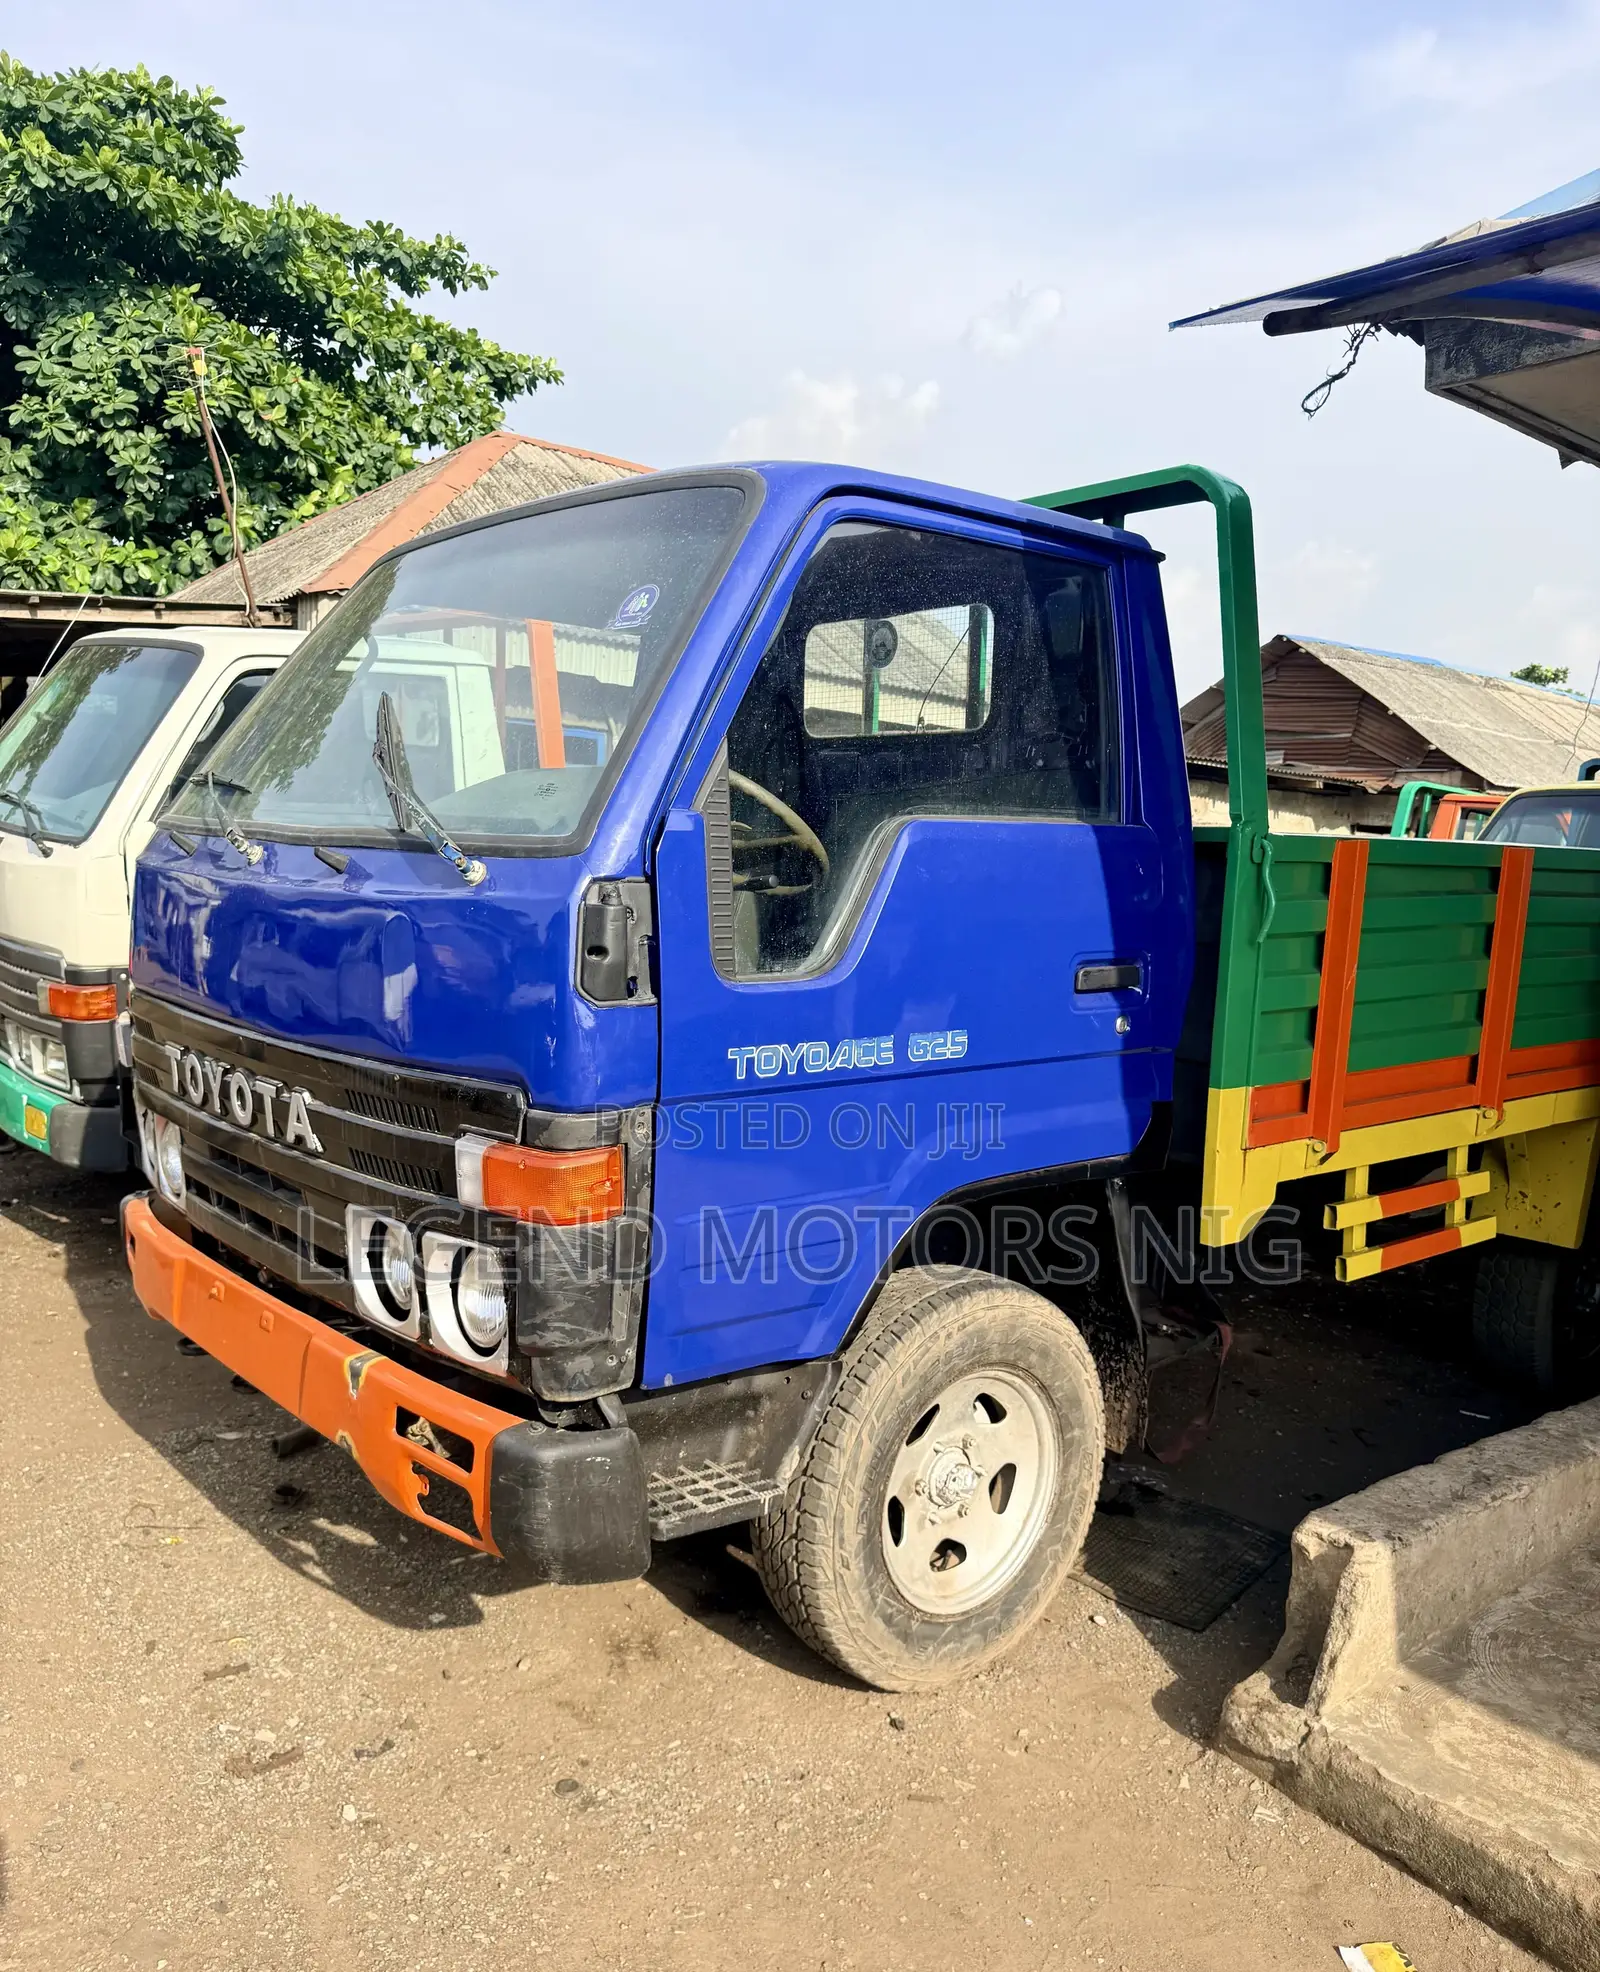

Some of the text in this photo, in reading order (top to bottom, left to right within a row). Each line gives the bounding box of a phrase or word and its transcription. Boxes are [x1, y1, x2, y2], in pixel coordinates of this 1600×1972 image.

[728, 1030, 968, 1079] TOYOACE G25
[164, 1041, 324, 1153] TOYOTA
